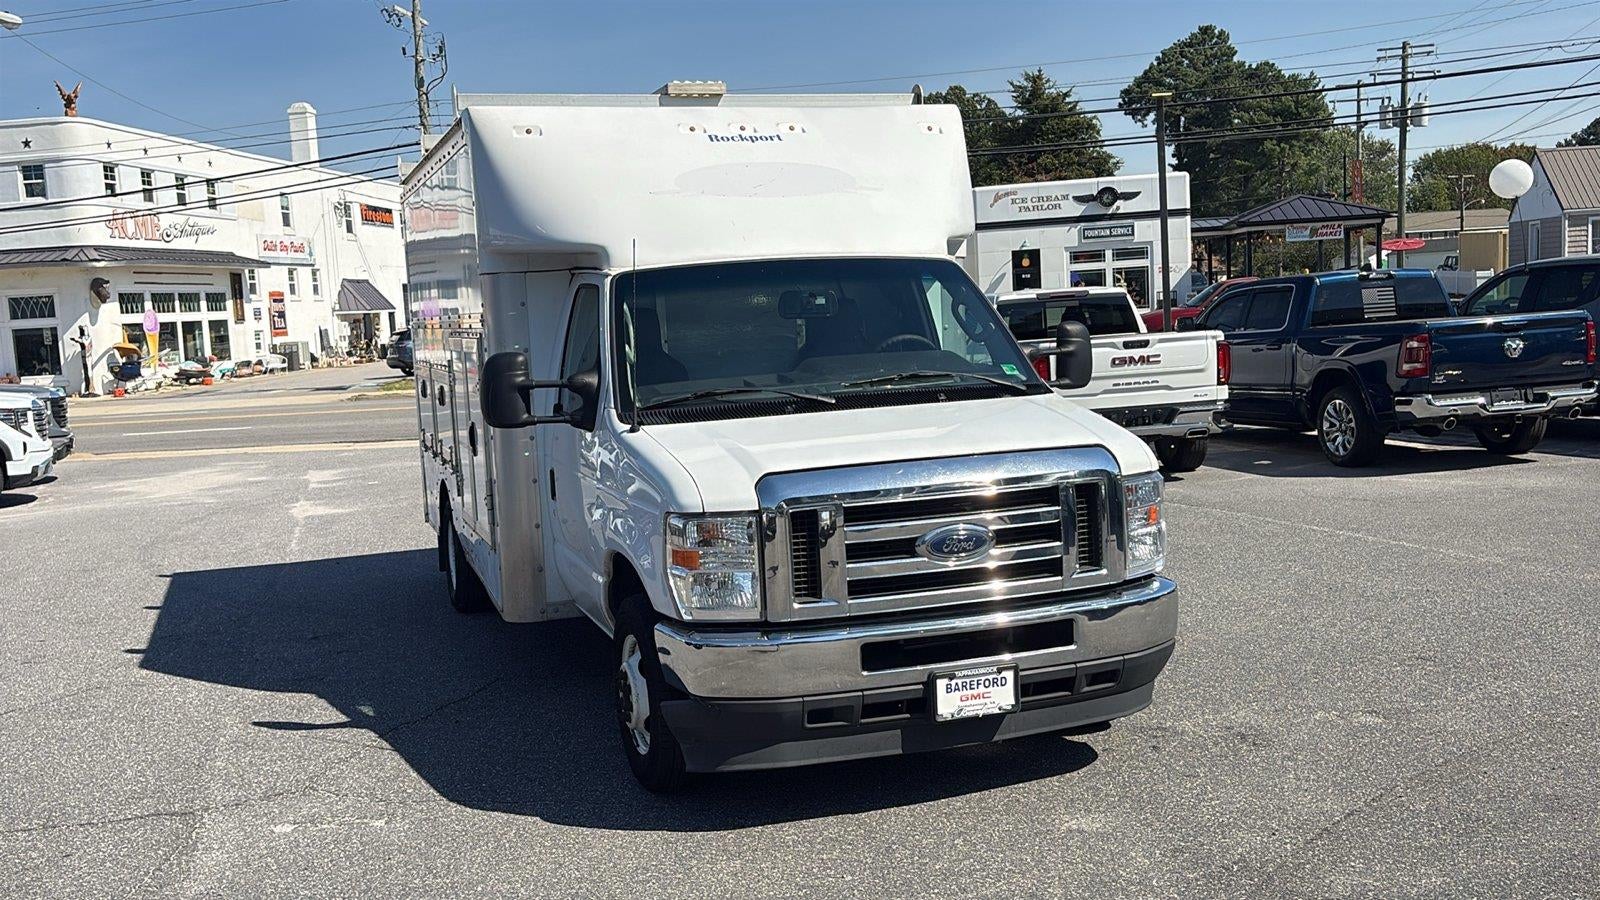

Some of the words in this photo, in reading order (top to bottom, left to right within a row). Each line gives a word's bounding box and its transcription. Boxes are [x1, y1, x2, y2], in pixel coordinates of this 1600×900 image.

[707, 133, 785, 144] Rockport
[1010, 197, 1028, 205] ICE
[1030, 193, 1070, 204] CREAM
[1018, 203, 1062, 213] PARLOR
[105, 209, 162, 241] ACME
[1084, 228, 1110, 238] FOUNTAIN
[1111, 226, 1133, 236] SERVICE
[1110, 354, 1162, 368] GMC
[942, 535, 976, 553] Ford
[945, 676, 1008, 694] BAREFORD
[959, 691, 992, 702] GMC
